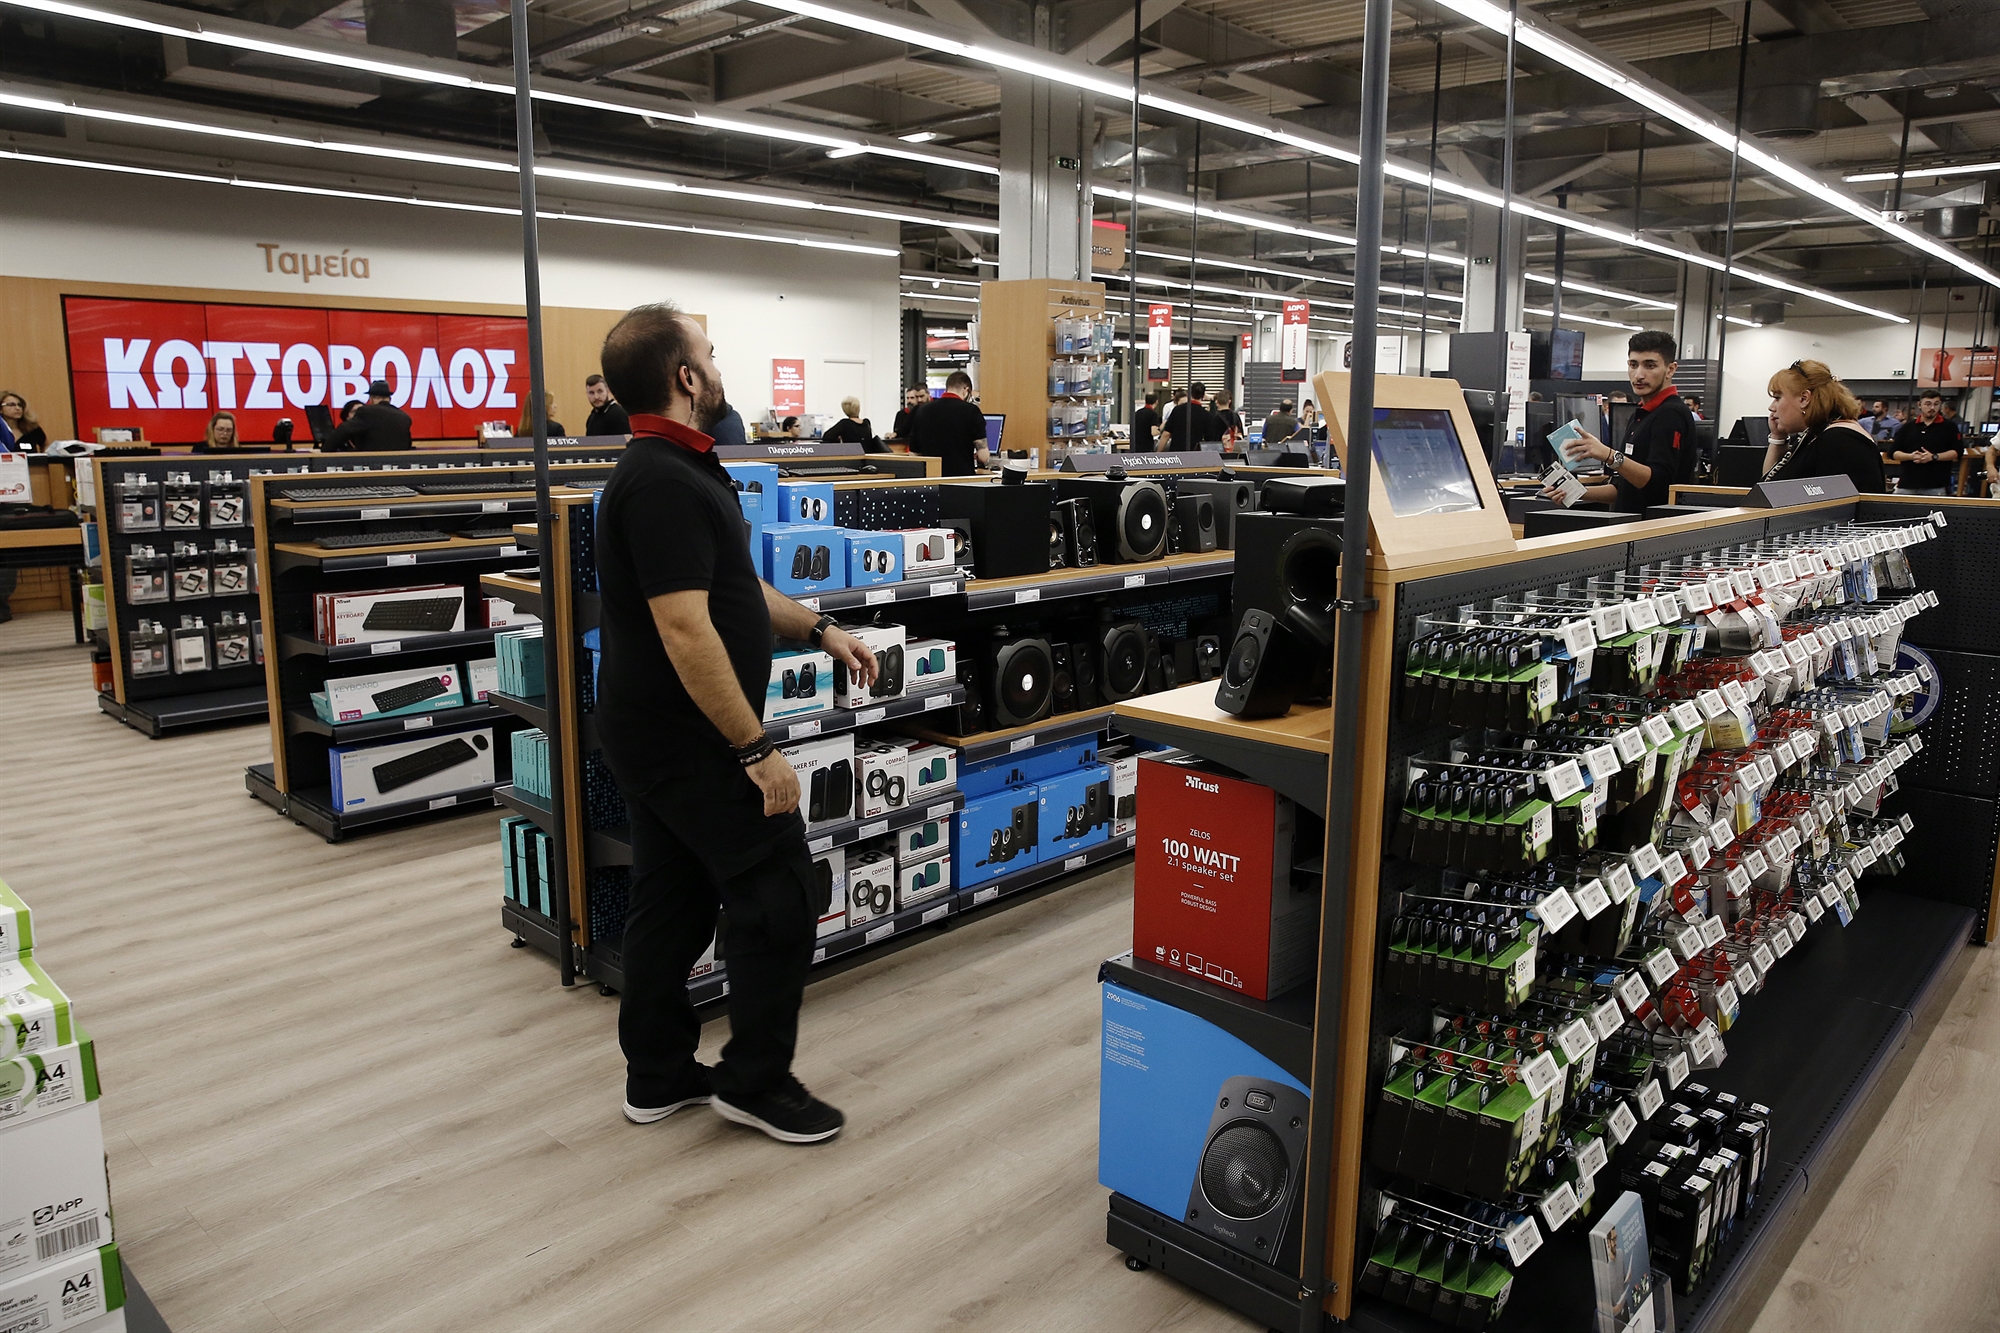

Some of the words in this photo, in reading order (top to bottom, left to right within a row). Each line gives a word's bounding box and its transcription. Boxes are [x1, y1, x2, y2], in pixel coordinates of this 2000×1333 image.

[257, 243, 370, 283] Ταμεία
[1061, 295, 1091, 306] Antivirus
[104, 338, 516, 410] ΚΩΤΣΟΒΟΛΟΣ
[768, 446, 814, 455] Πληκτρολόγια
[1121, 456, 1142, 467] Ηχεία
[334, 681, 379, 693] KEYBOARD
[885, 756, 906, 765] COMPACT
[1193, 777, 1219, 793] Trust
[1189, 828, 1211, 840] ZELOS
[1162, 837, 1189, 859] 100
[1193, 845, 1241, 873] WATT
[871, 865, 892, 875] COMPACT
[1167, 856, 1179, 867] 2.1
[1181, 861, 1217, 877] speaker
[1219, 872, 1234, 883] set
[1180, 891, 1205, 904] POWERFUL
[1205, 898, 1217, 907] BASS
[1180, 898, 1199, 909] ROBUST
[1199, 903, 1217, 913] DESIGN
[1106, 991, 1121, 1003] Z906
[17, 1020, 41, 1036] A4
[36, 1063, 66, 1085] A4
[55, 1198, 83, 1215] APP
[1213, 1223, 1237, 1239] logitech
[61, 1273, 92, 1297] A4
[62, 1297, 74, 1306] 80
